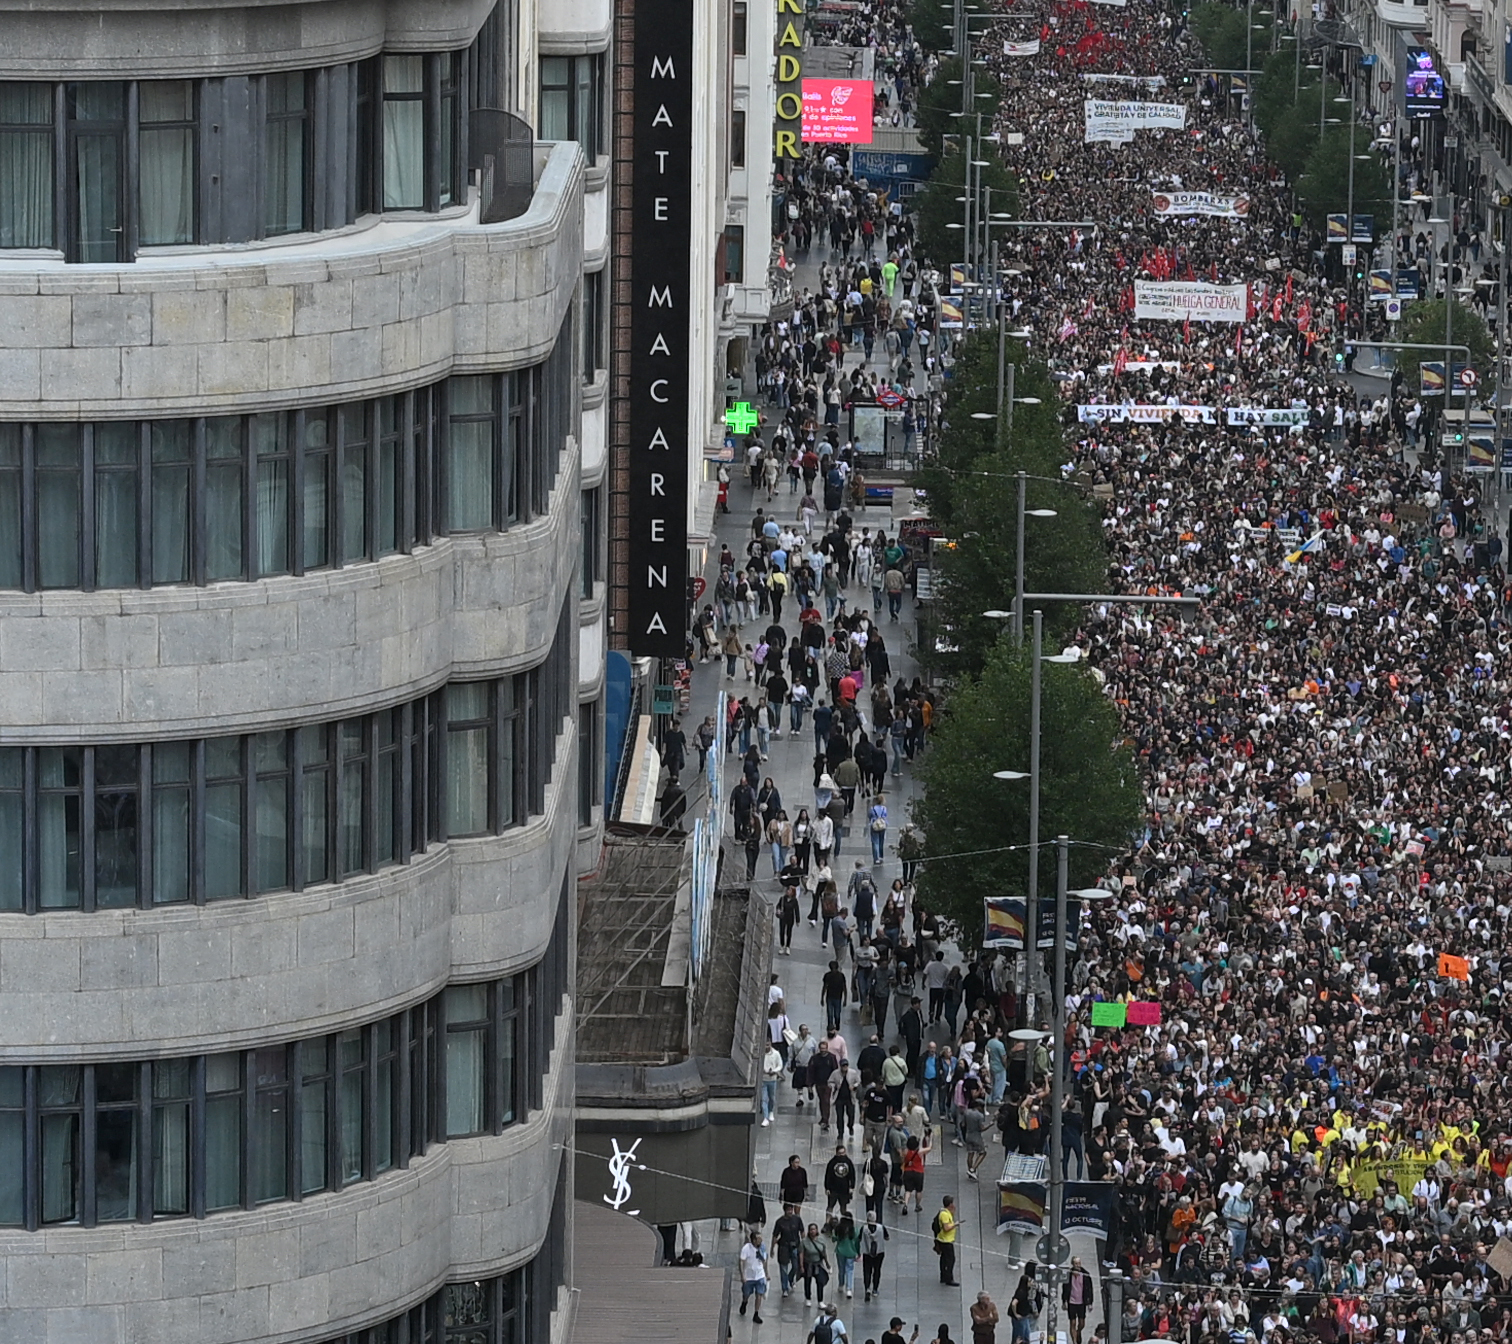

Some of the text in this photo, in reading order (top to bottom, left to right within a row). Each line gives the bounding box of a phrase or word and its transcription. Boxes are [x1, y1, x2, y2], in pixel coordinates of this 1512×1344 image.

[650, 56, 676, 221] MATE
[646, 285, 673, 635] MACARENA
[1096, 408, 1122, 419] SIN
[1233, 411, 1267, 422] HAY
